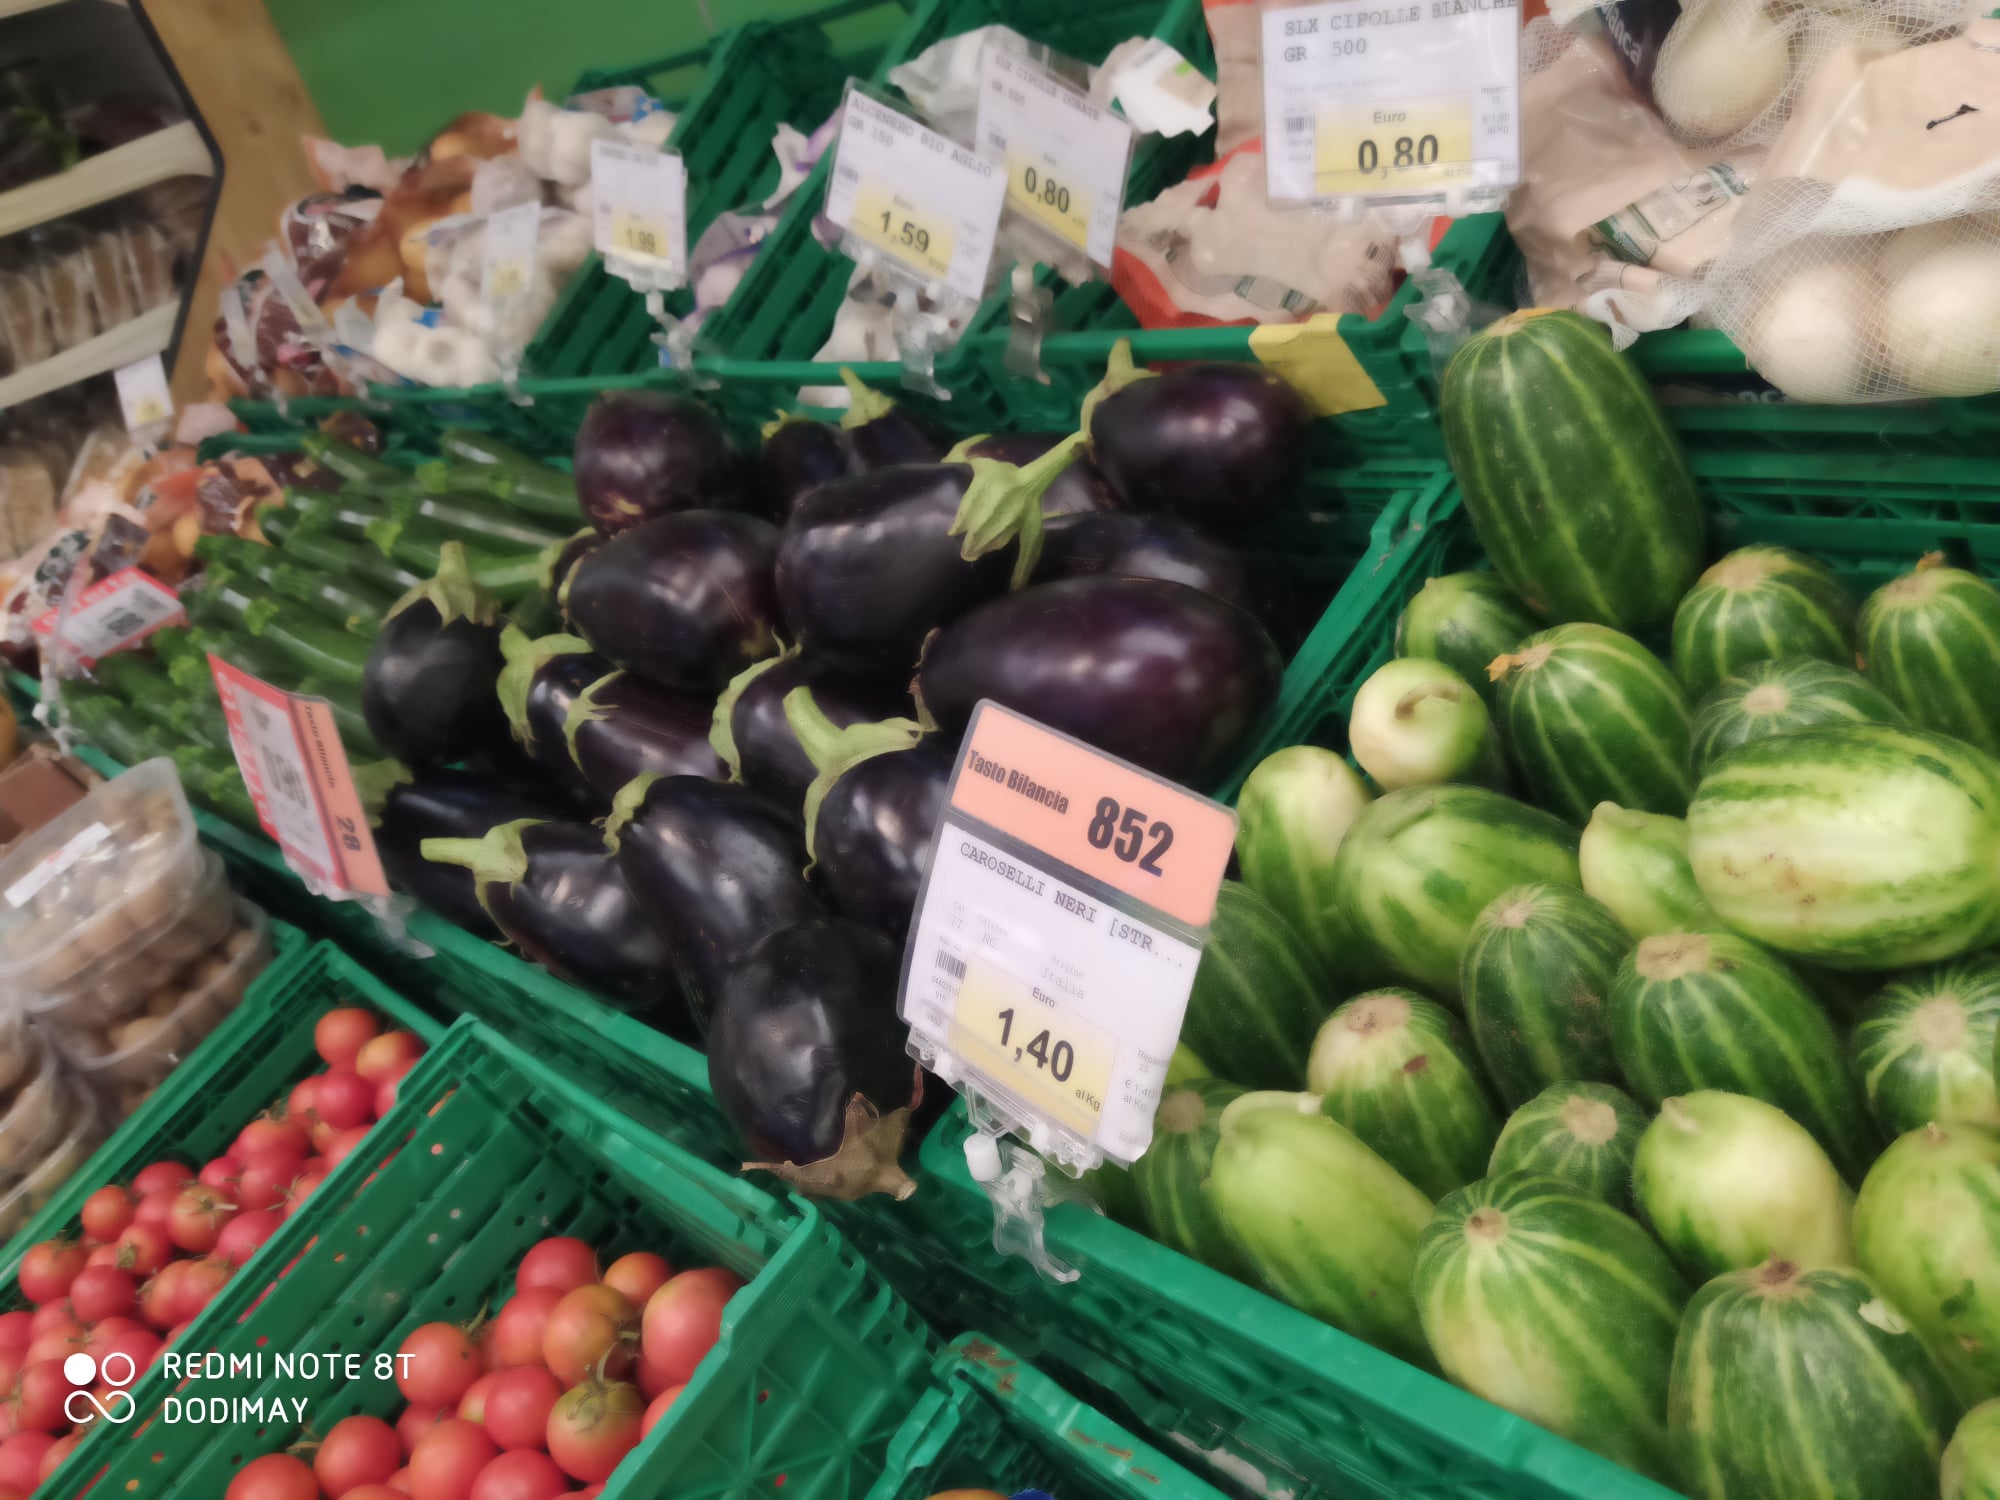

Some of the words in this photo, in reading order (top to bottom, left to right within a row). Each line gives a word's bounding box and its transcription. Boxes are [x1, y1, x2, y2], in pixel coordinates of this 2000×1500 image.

[1285, 18, 1320, 37] SLX
[1330, 6, 1420, 32] CIPOLLE
[1432, 0, 1519, 19] BIANCHE
[1332, 38, 1368, 57] 500
[1016, 65, 1057, 98] CIPOLLE
[1063, 93, 1100, 121] DORATE
[852, 98, 914, 137] ALCENERO
[920, 134, 945, 153] BIO
[950, 150, 992, 178] AGLIO
[872, 126, 893, 147] 150
[1373, 111, 1406, 124] Euro
[1358, 133, 1439, 181] 0,80
[1025, 166, 1070, 213] 0,80
[880, 210, 930, 253] 1,59
[967, 750, 1006, 784] Tasto
[1006, 769, 1069, 815] Bilancia
[1087, 796, 1174, 878] 852
[960, 841, 1046, 897] CAROSELLI
[1054, 890, 1097, 924] NERI
[1031, 986, 1055, 1008] Euro
[1042, 967, 1084, 999] Italia
[998, 1007, 1074, 1083] 1,40
[1085, 1090, 1100, 1112] Kg
